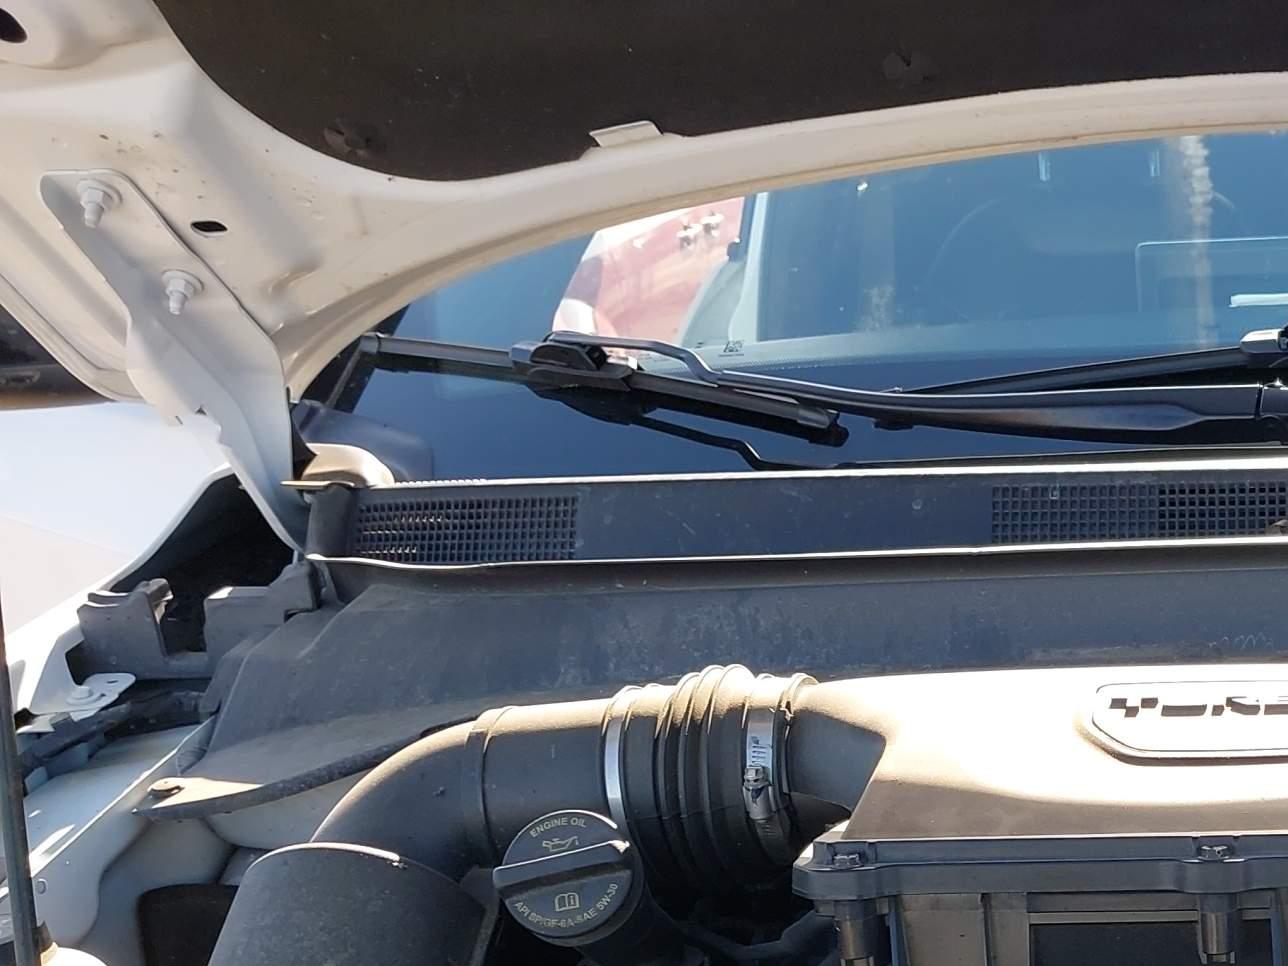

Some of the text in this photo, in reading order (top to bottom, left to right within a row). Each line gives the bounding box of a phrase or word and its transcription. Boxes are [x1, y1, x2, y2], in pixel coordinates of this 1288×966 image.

[529, 817, 587, 838] ENGINE OIL
[514, 901, 530, 917] API
[596, 883, 619, 911] 5W-30
